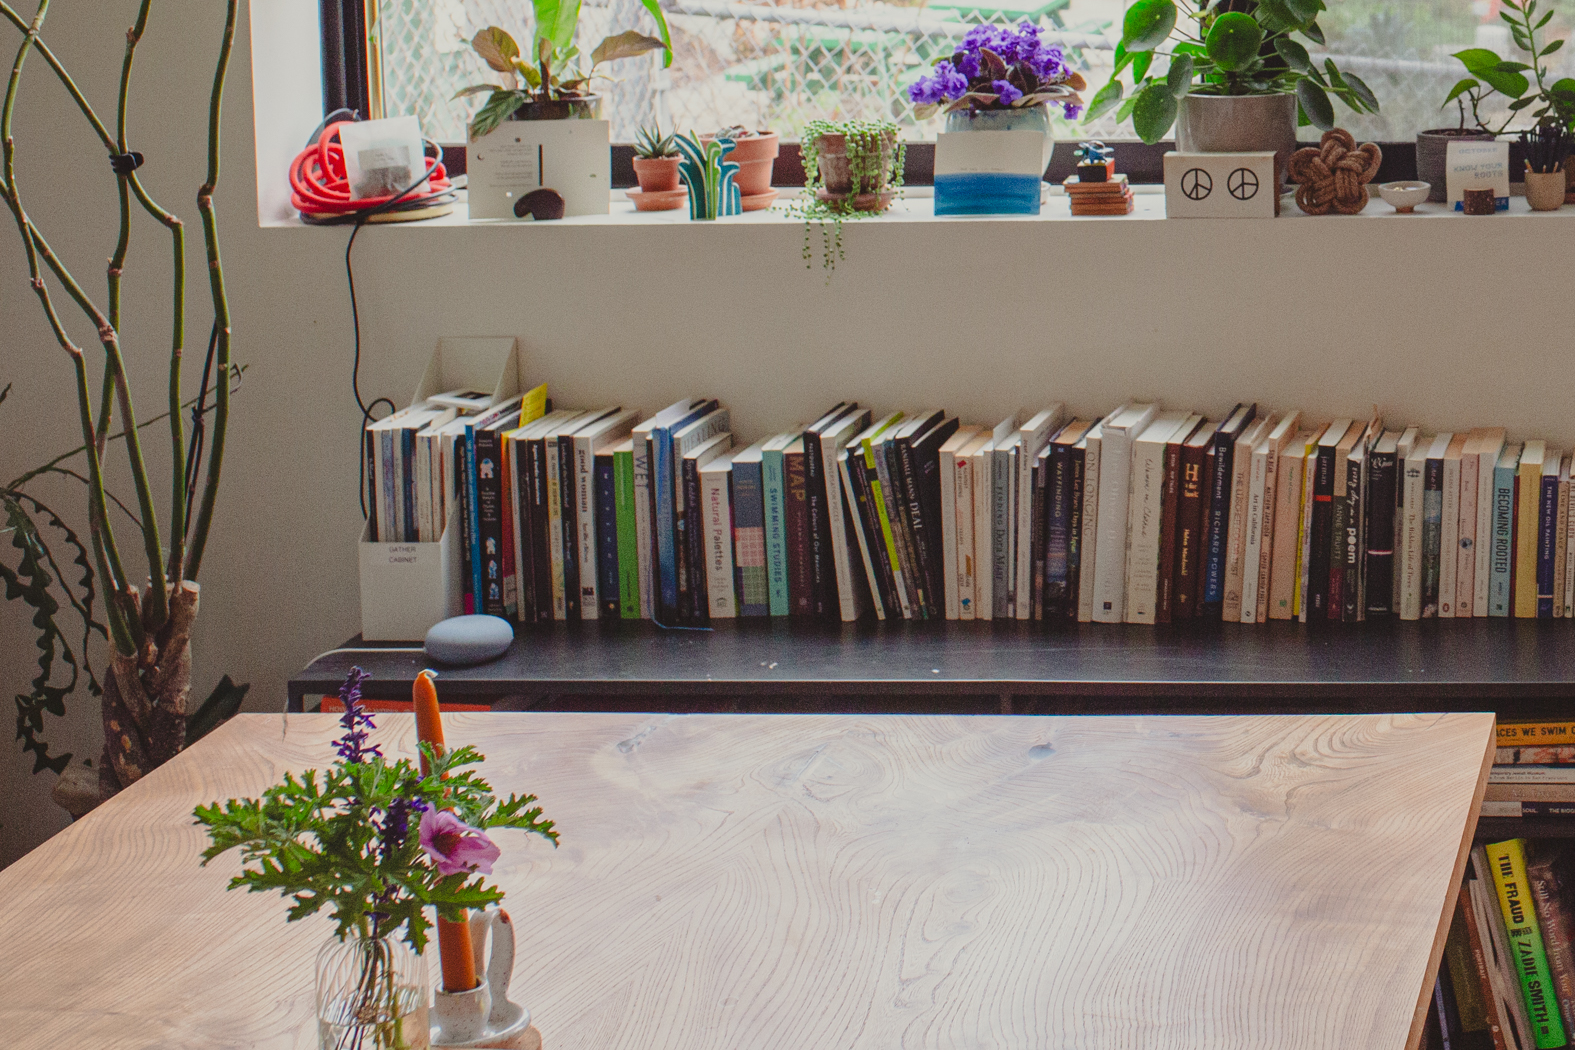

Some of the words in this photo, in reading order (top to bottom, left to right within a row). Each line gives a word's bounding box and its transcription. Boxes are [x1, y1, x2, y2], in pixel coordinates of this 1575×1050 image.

[635, 454, 648, 489] WET
[789, 456, 806, 501] MAP
[1086, 451, 1096, 471] ON
[1215, 446, 1227, 499] Bewilderment
[1319, 456, 1328, 485] jarman
[900, 443, 911, 475] RANDALL
[910, 502, 922, 530] DEAL
[1054, 461, 1064, 517] WAYFINDING
[710, 488, 721, 526] Natural
[770, 488, 781, 540] SWIMMING
[1084, 477, 1095, 537] LONGING
[1252, 504, 1259, 512] in
[1335, 504, 1343, 528] ANNE
[1496, 487, 1511, 536] BECOMING
[1211, 510, 1222, 554] RICHARD
[1250, 513, 1259, 545] California
[1334, 530, 1342, 560] TRUITT
[1543, 528, 1551, 560] PAINTING
[713, 529, 724, 571] Palettes
[773, 543, 782, 583] STUDIES
[1494, 538, 1510, 574] ROOTED
[1209, 557, 1219, 596] POWERS
[1521, 727, 1536, 737] WE
[1541, 726, 1567, 736] SWIM
[1498, 853, 1512, 878] THE
[1504, 882, 1525, 924] FRAUD
[1536, 879, 1549, 899] Still
[1542, 902, 1552, 916] No
[1546, 920, 1558, 945] Word
[1474, 949, 1486, 979] PORTRAIT
[1517, 940, 1538, 977] ZADIE
[1552, 946, 1563, 971] from
[1559, 973, 1570, 992] You
[1527, 981, 1549, 1023] SMITH
